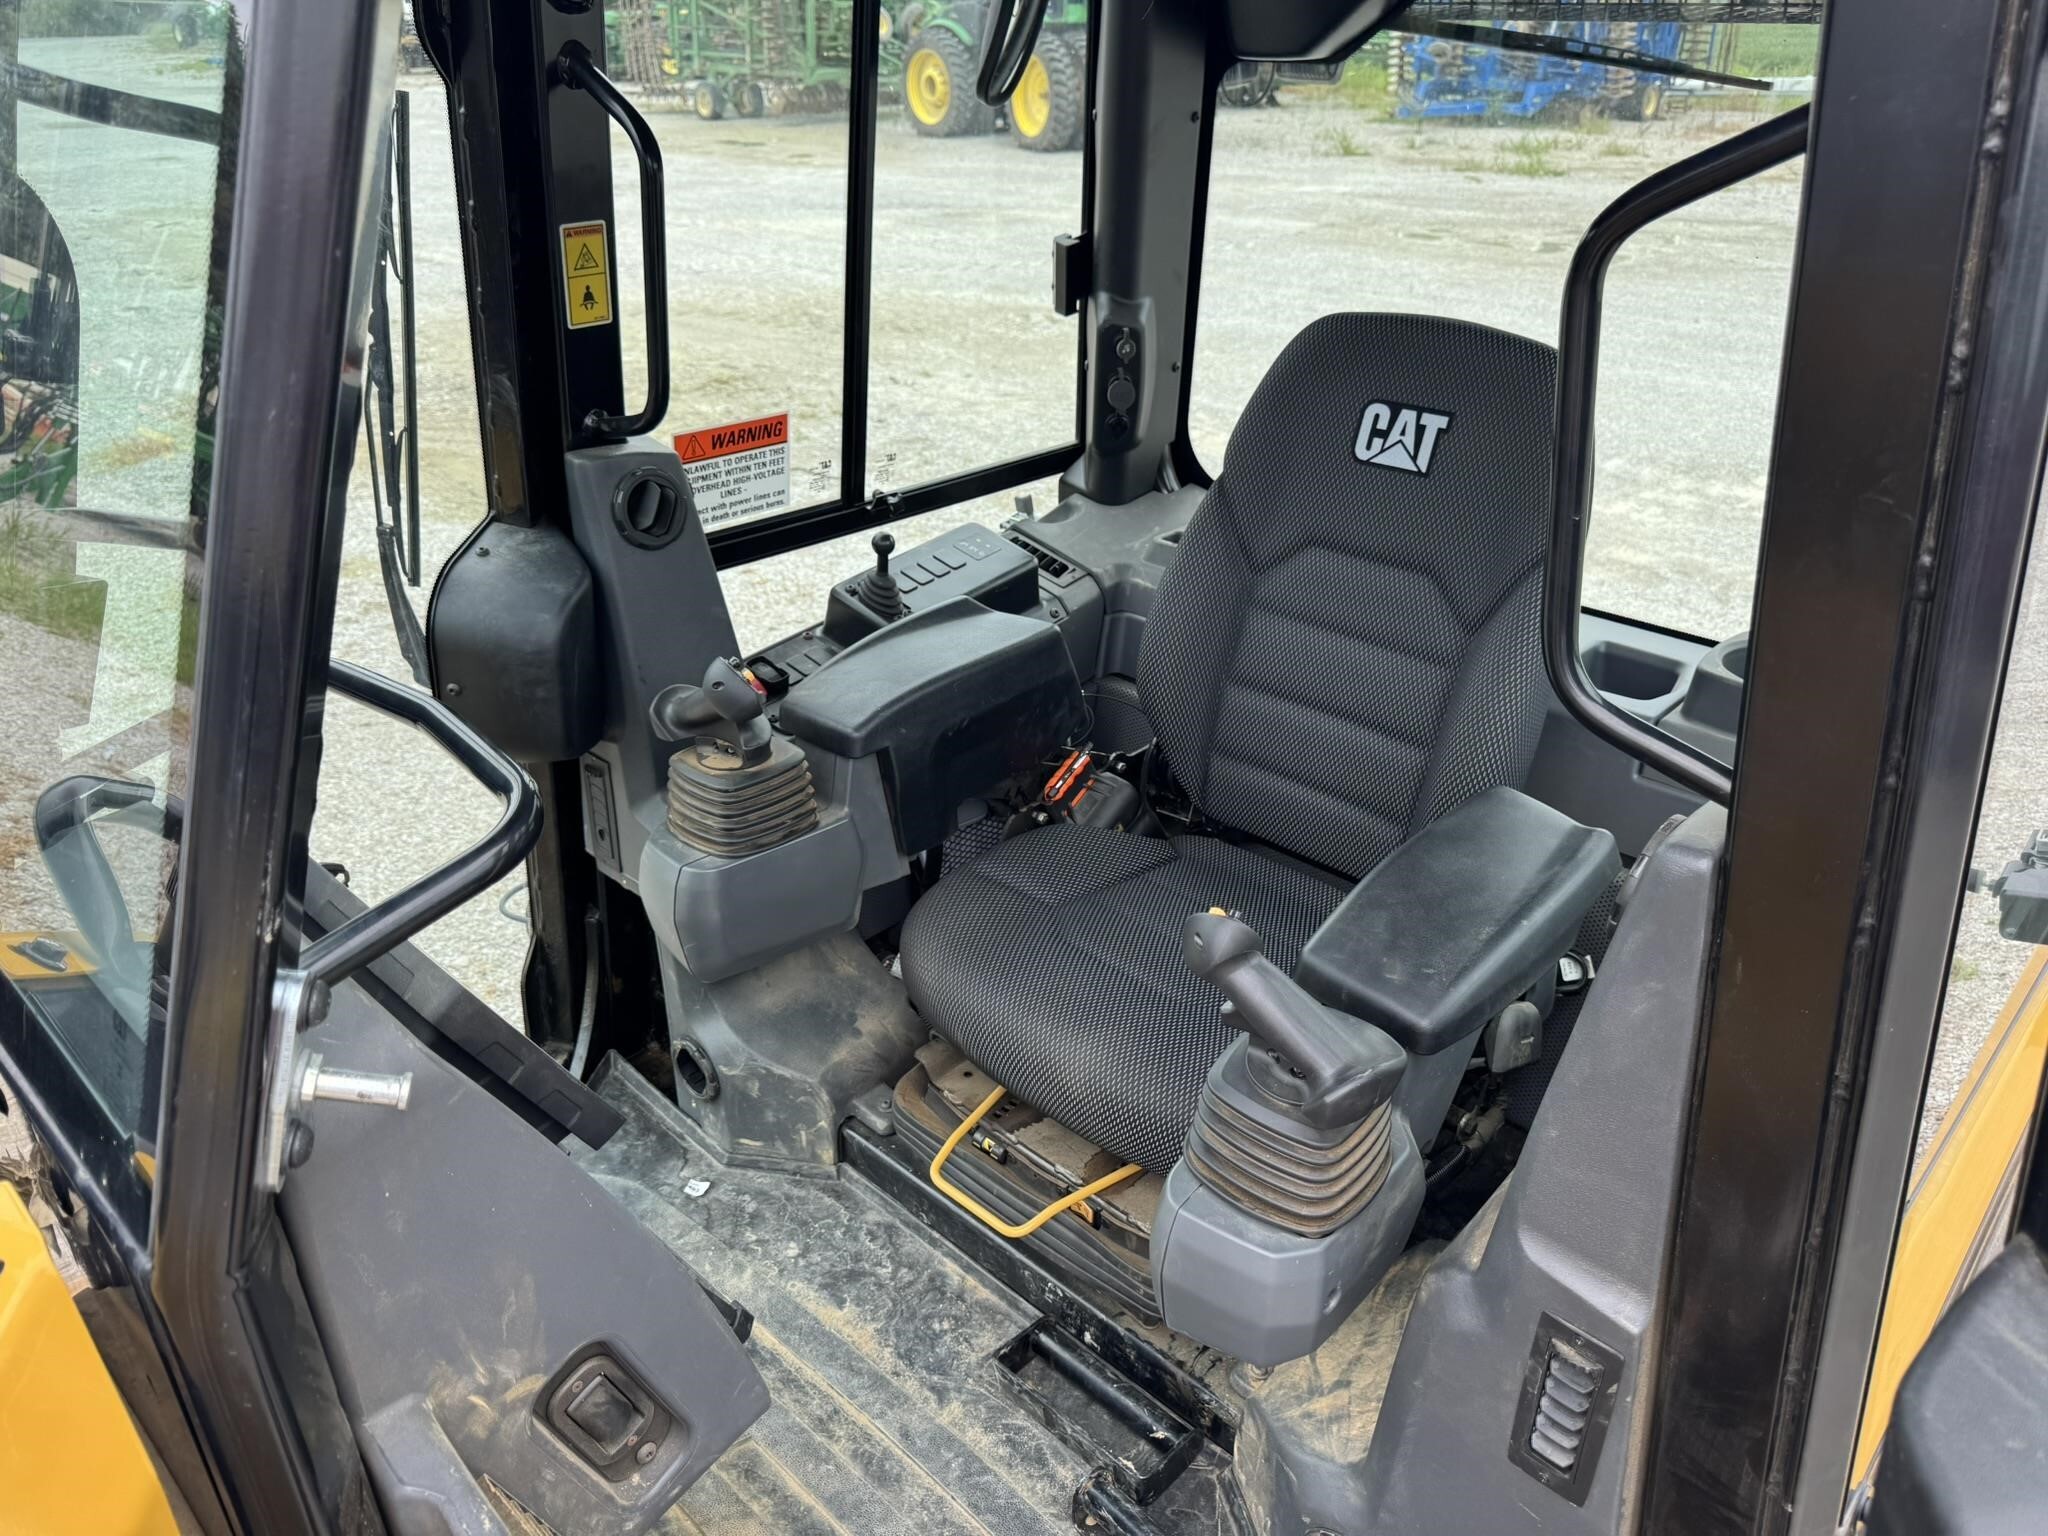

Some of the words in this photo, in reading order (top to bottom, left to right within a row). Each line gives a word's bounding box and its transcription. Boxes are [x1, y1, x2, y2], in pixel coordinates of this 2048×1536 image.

[711, 420, 783, 450] WARNING
[1354, 402, 1450, 474] CAT
[684, 462, 721, 475] NLAWFUL
[723, 458, 732, 467] TO
[735, 451, 768, 464] OPERATE
[769, 447, 785, 457] THIS
[688, 471, 722, 485] UIPMENT
[725, 464, 752, 477] WITHIN
[754, 461, 767, 470] TEN
[769, 457, 785, 467] FEET
[733, 468, 785, 485] HIGH-VOLTAGE
[711, 502, 727, 513] with
[729, 497, 752, 509] power
[754, 492, 771, 501] lines
[773, 489, 785, 498] can
[720, 487, 742, 499] LINES
[702, 517, 709, 525] in
[711, 512, 730, 522] death
[731, 509, 740, 517] or
[741, 503, 764, 515] serious
